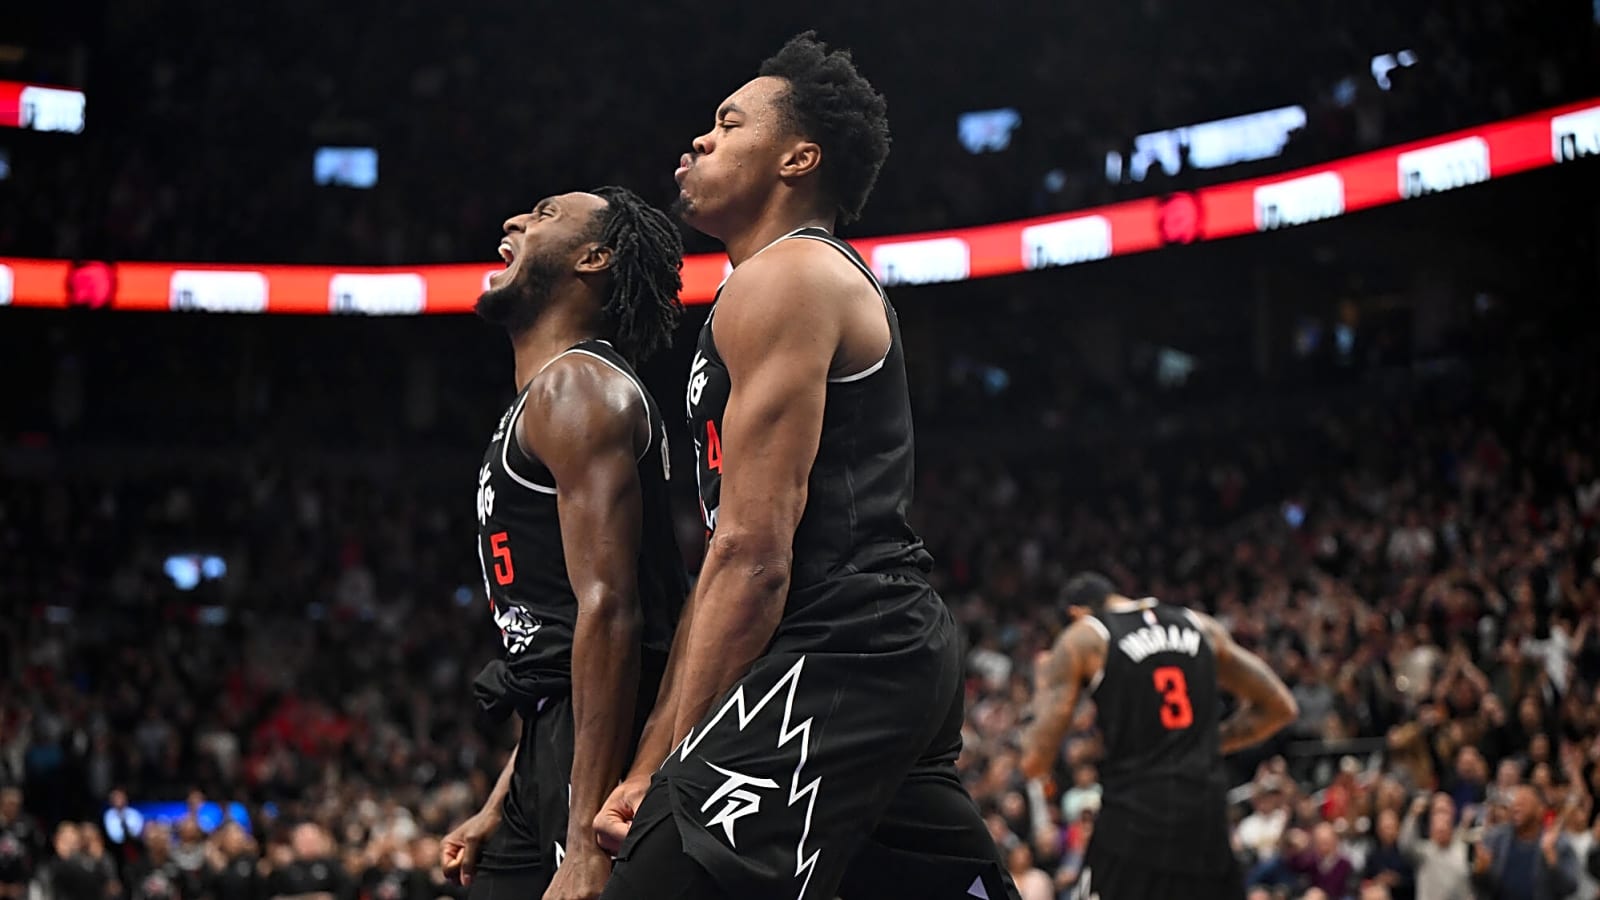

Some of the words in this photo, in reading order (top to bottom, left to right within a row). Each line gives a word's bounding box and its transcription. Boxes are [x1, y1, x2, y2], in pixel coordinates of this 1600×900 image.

[706, 419, 722, 474] 4
[490, 532, 515, 586] 5
[1119, 624, 1201, 663] INGRAM
[1153, 666, 1194, 730] 3
